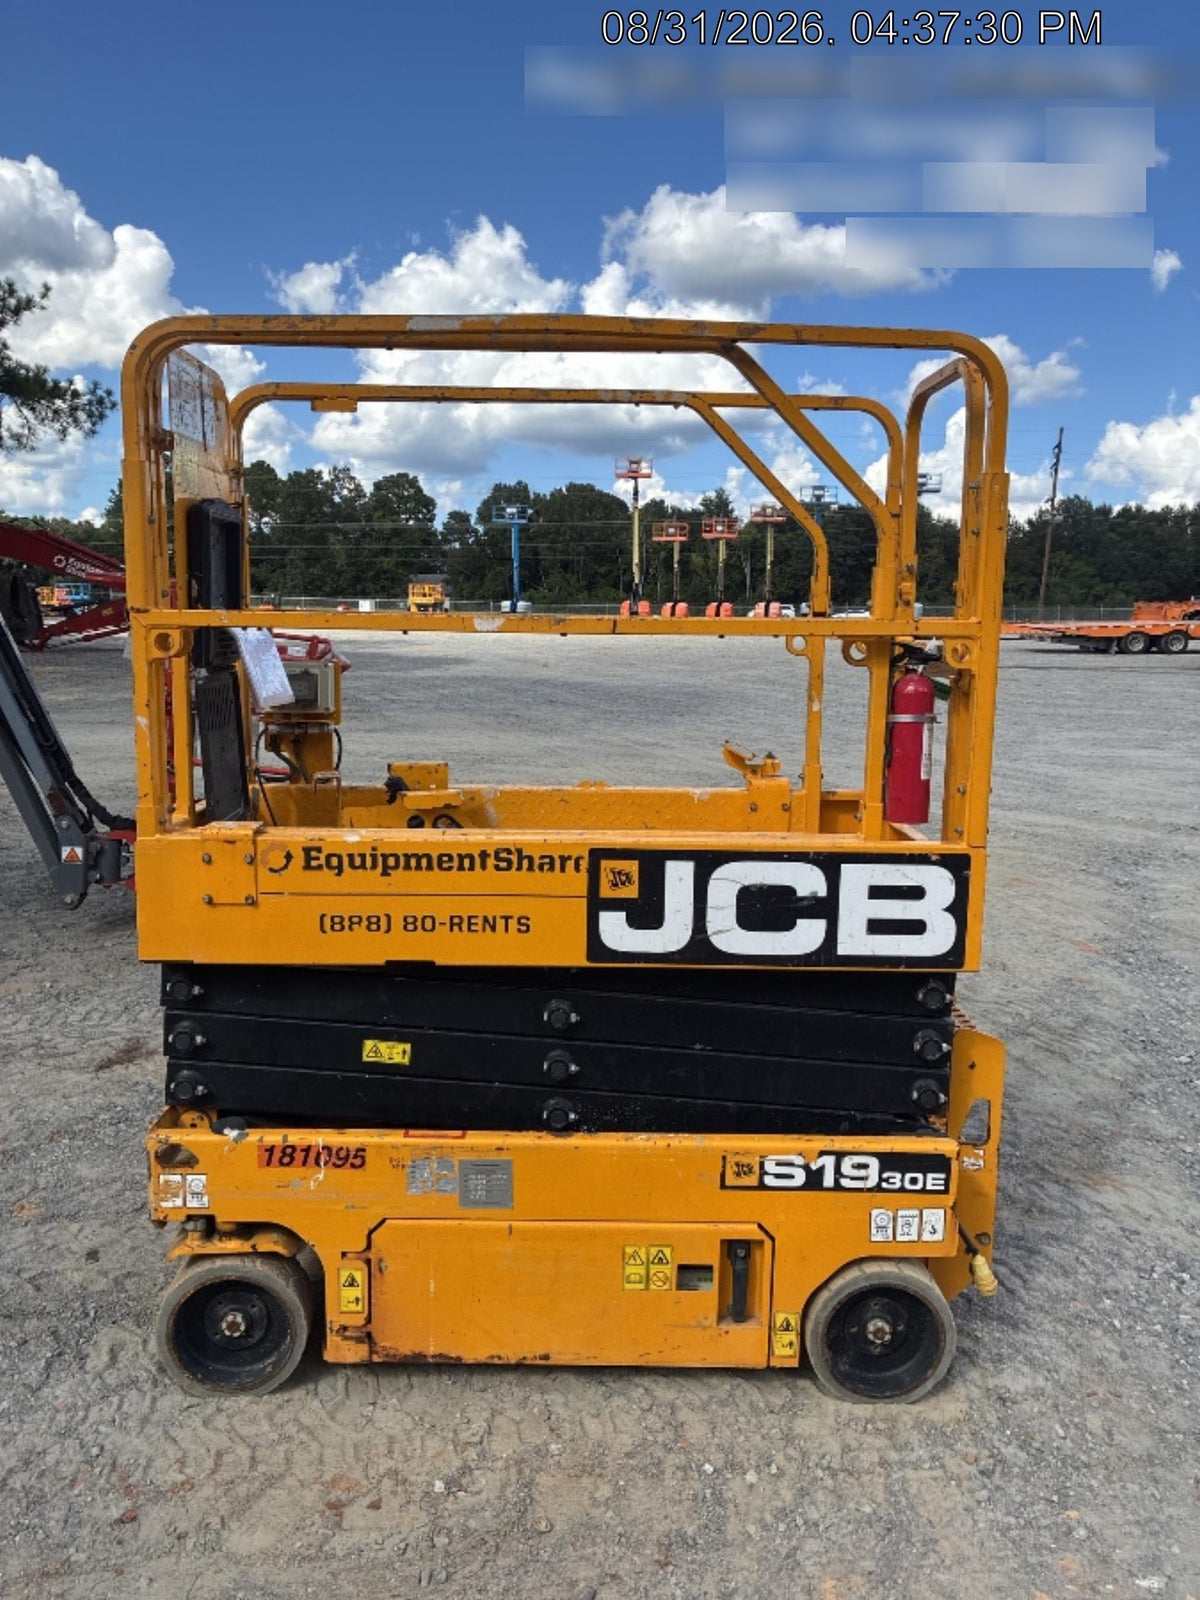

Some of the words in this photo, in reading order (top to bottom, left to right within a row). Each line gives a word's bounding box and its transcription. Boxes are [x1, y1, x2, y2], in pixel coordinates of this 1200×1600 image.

[598, 860, 957, 957] JCB
[402, 914, 531, 934] 80-RENTS
[264, 1144, 367, 1169] 181095
